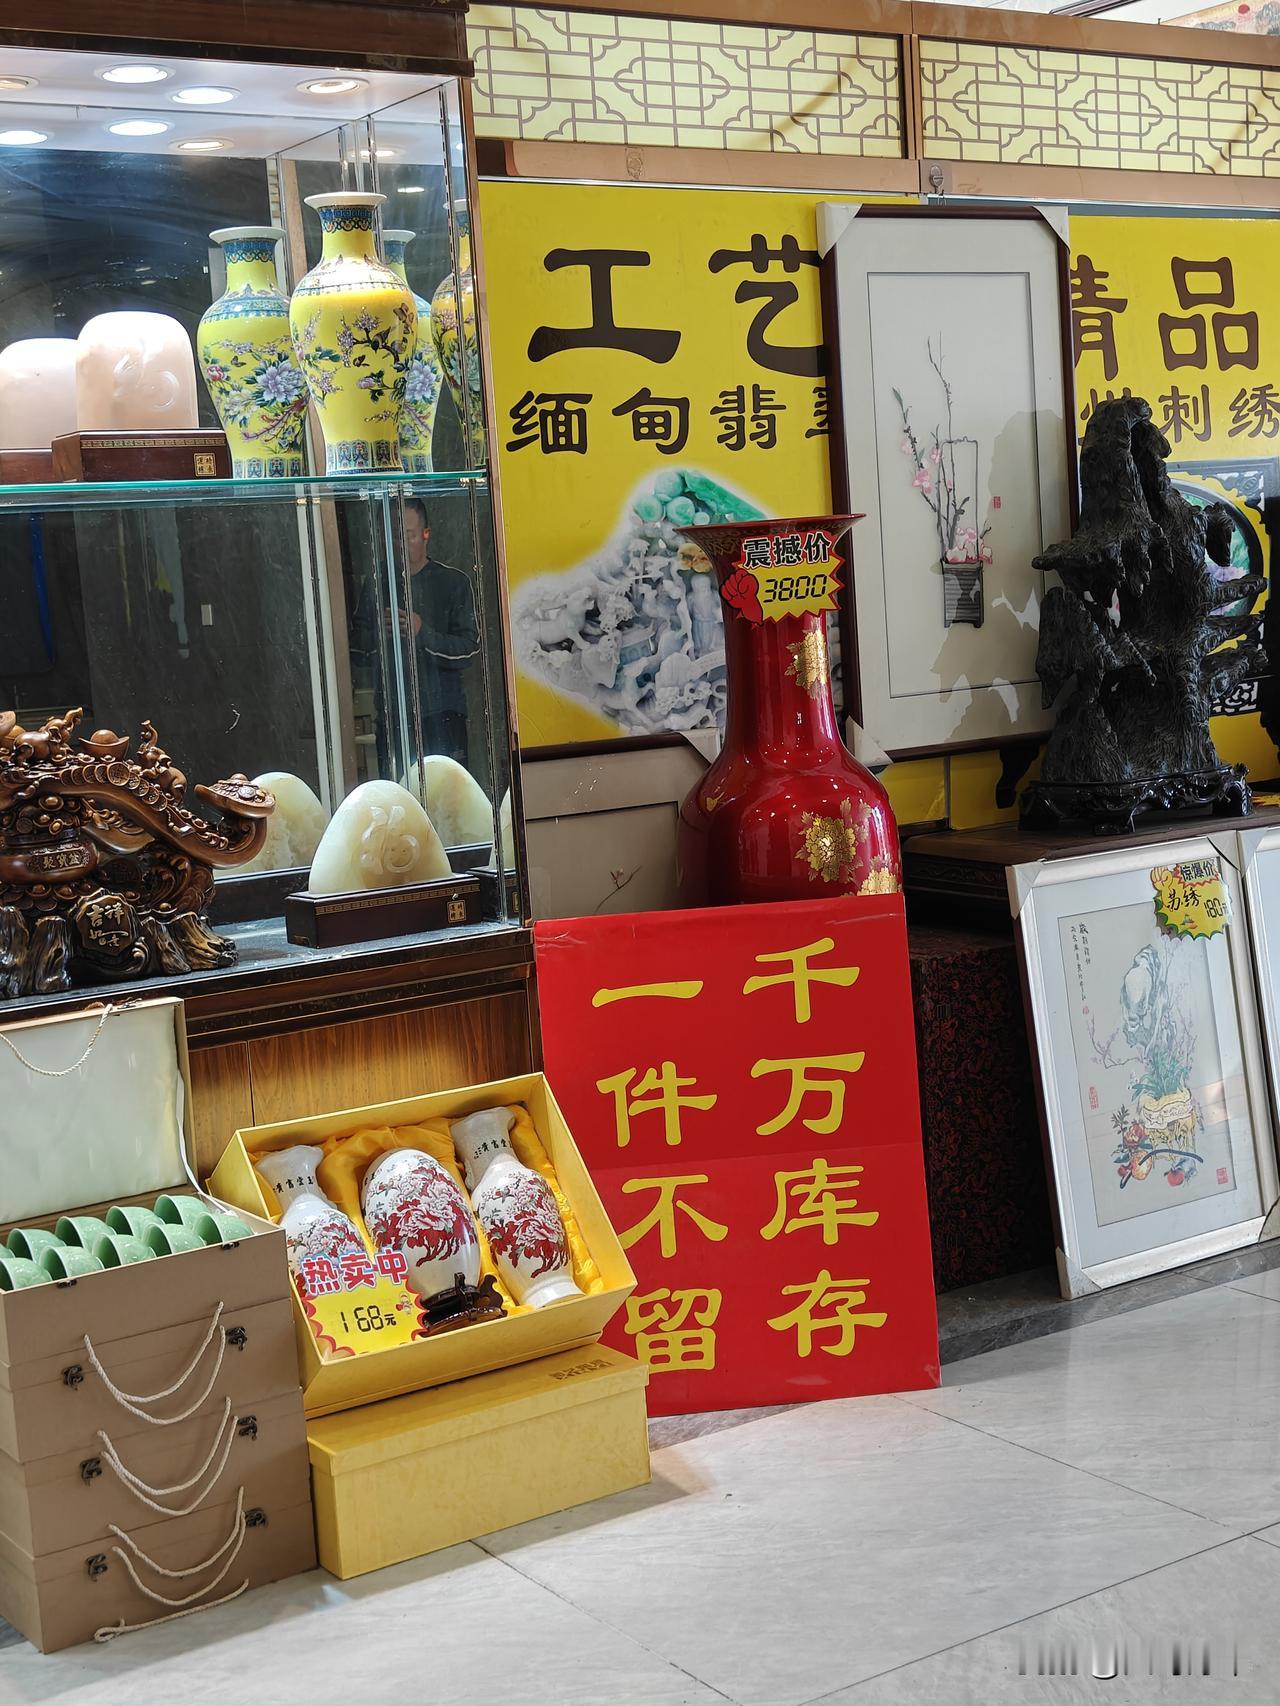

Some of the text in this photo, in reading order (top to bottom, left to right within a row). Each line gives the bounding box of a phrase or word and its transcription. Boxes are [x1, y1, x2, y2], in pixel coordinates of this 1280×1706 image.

[527, 234, 825, 378] 工艺
[743, 532, 831, 568] 震撼价
[763, 573, 828, 604] 3800
[1180, 860, 1214, 881] 惊爆价
[742, 936, 888, 1358] 千万库存
[591, 979, 729, 1375] 一件不留
[302, 1248, 408, 1294] 热卖中
[340, 1305, 397, 1333] 168元
